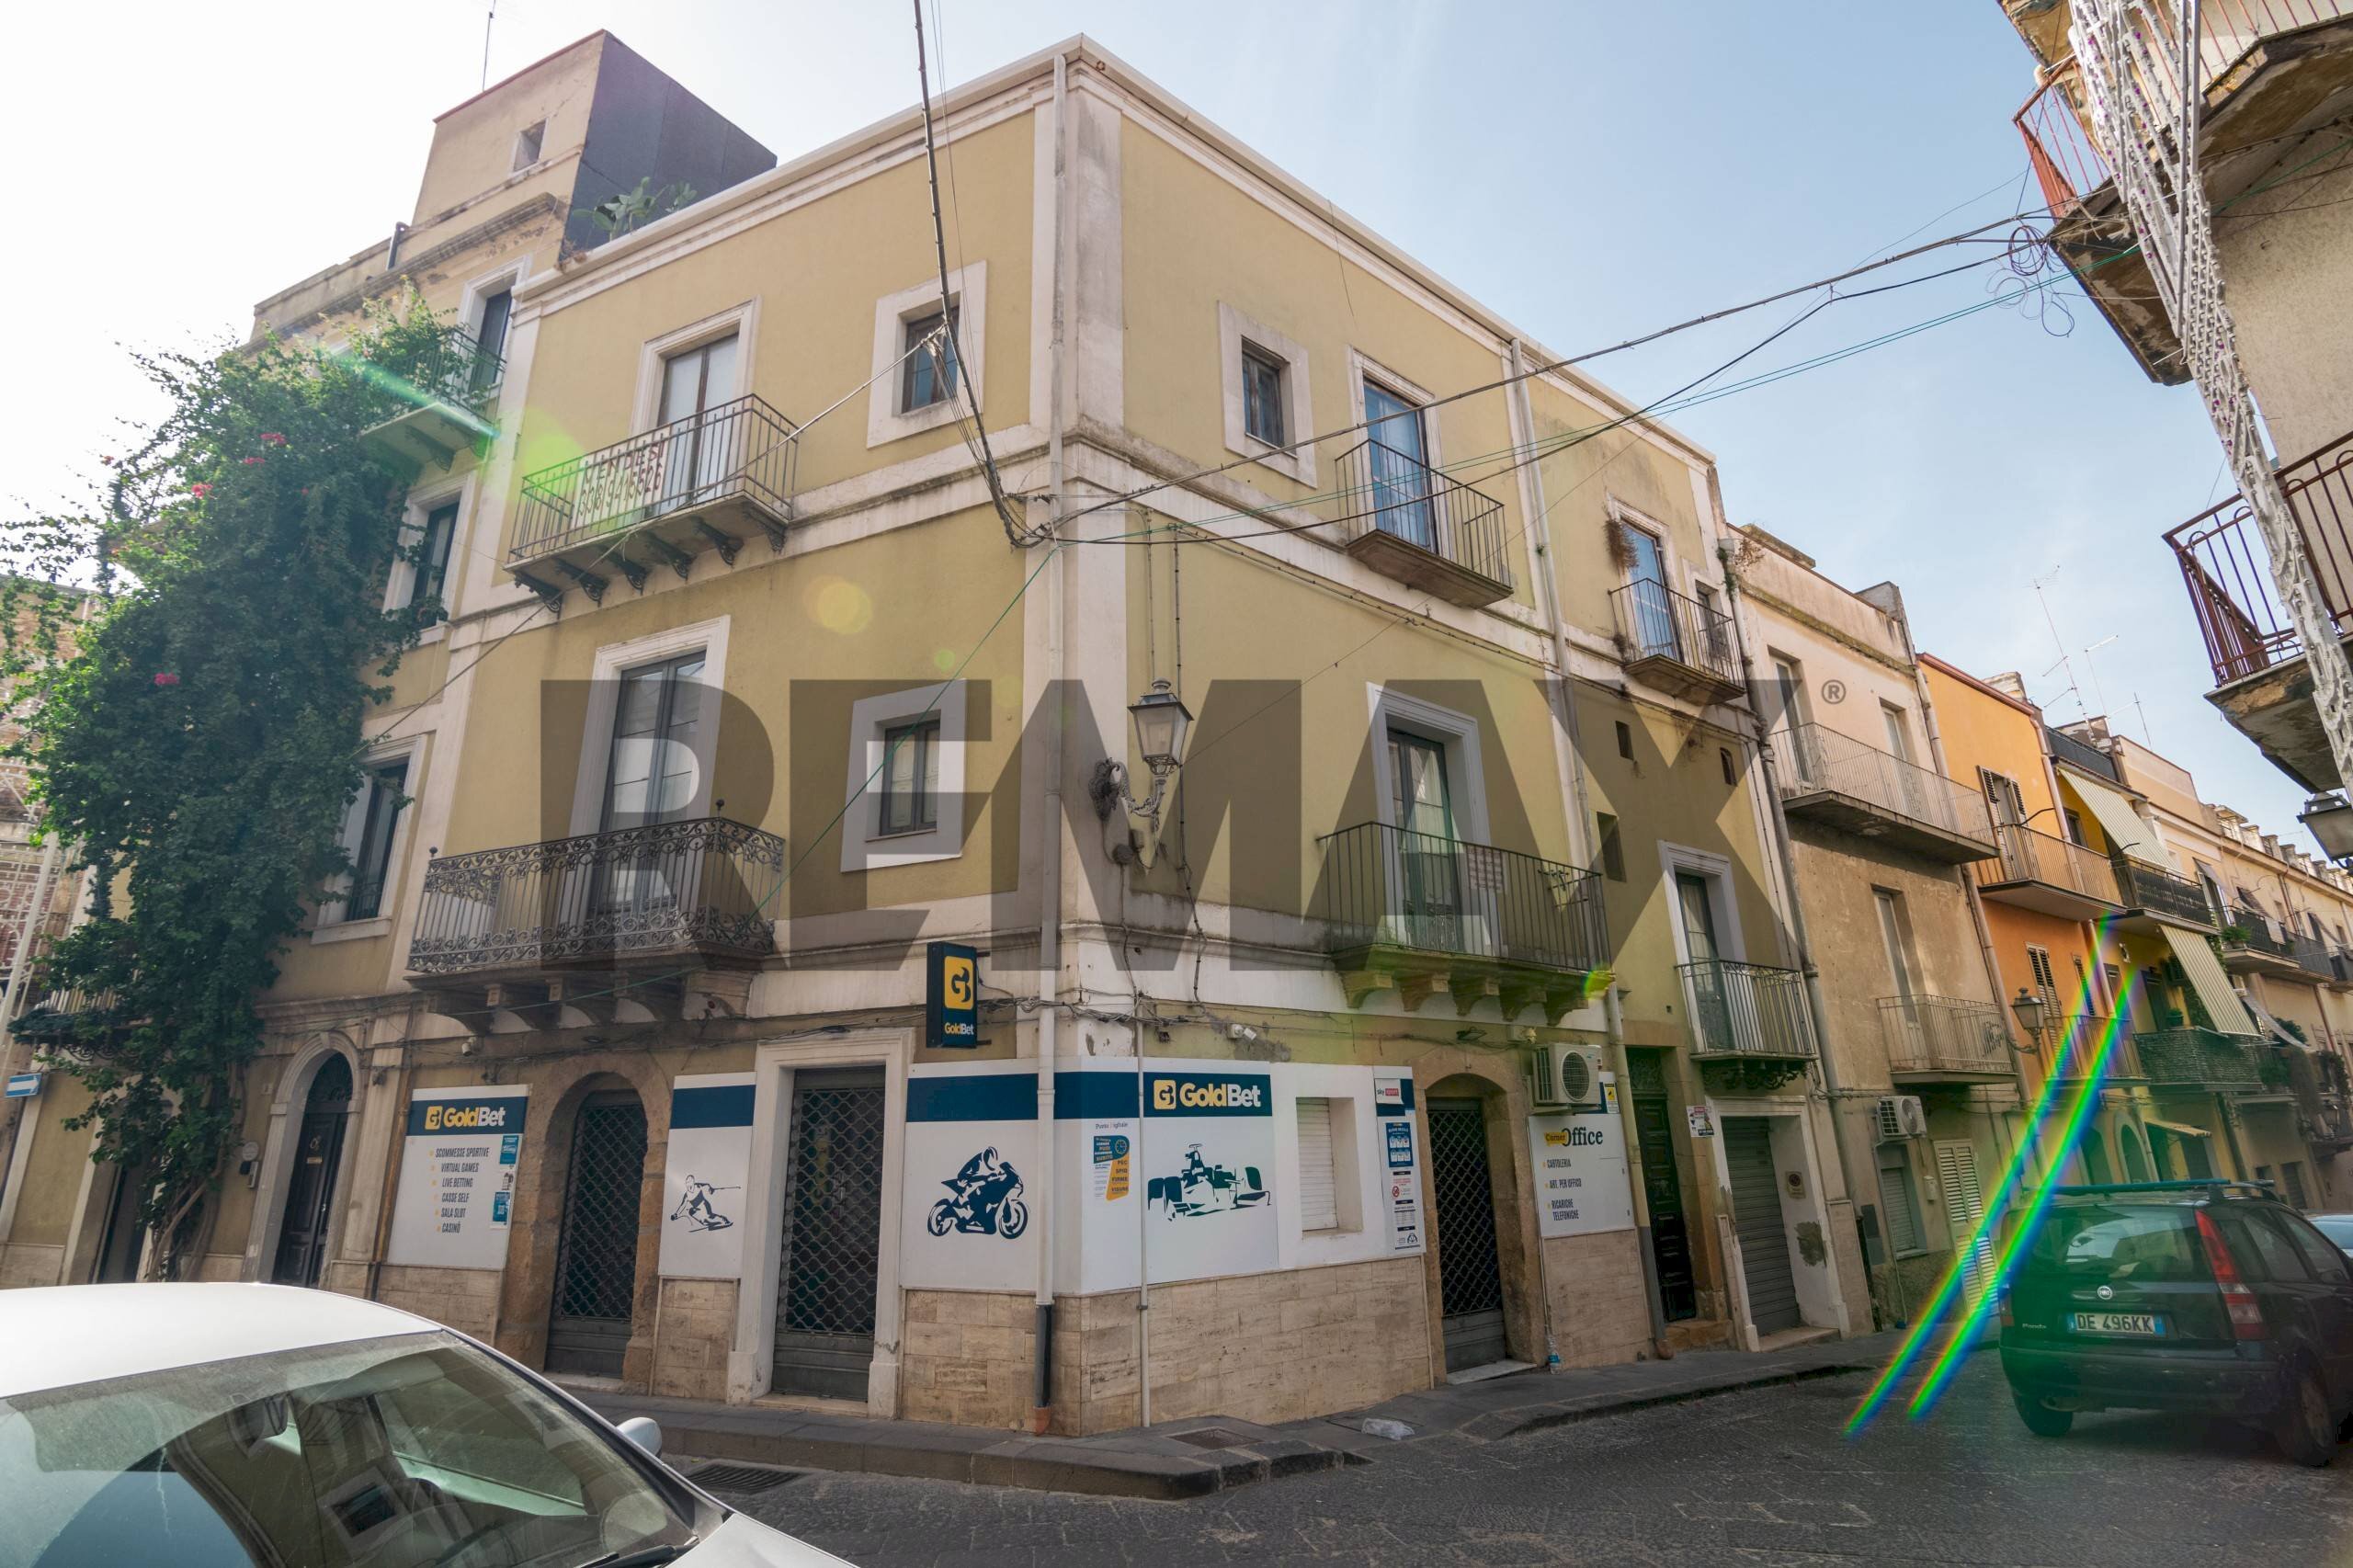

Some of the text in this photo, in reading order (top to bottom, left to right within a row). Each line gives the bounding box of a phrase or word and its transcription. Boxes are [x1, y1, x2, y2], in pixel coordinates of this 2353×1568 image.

[585, 441, 665, 484] VENDESI
[944, 1022, 974, 1035] GoldBet
[1179, 1083, 1262, 1108] GoldBet
[443, 1107, 506, 1128] GoldBet
[1561, 1127, 1604, 1147] Office
[436, 1147, 465, 1158] SCOMMESSE
[466, 1146, 490, 1158] SPORTIVE
[441, 1163, 480, 1173] VIRTUAL GAMES
[442, 1177, 473, 1187] LIVE BETTING
[441, 1193, 470, 1203] CASSE SELF
[441, 1208, 466, 1218] SALA SLOT
[2076, 1313, 2096, 1330] DE
[2102, 1315, 2154, 1332] 496KK
